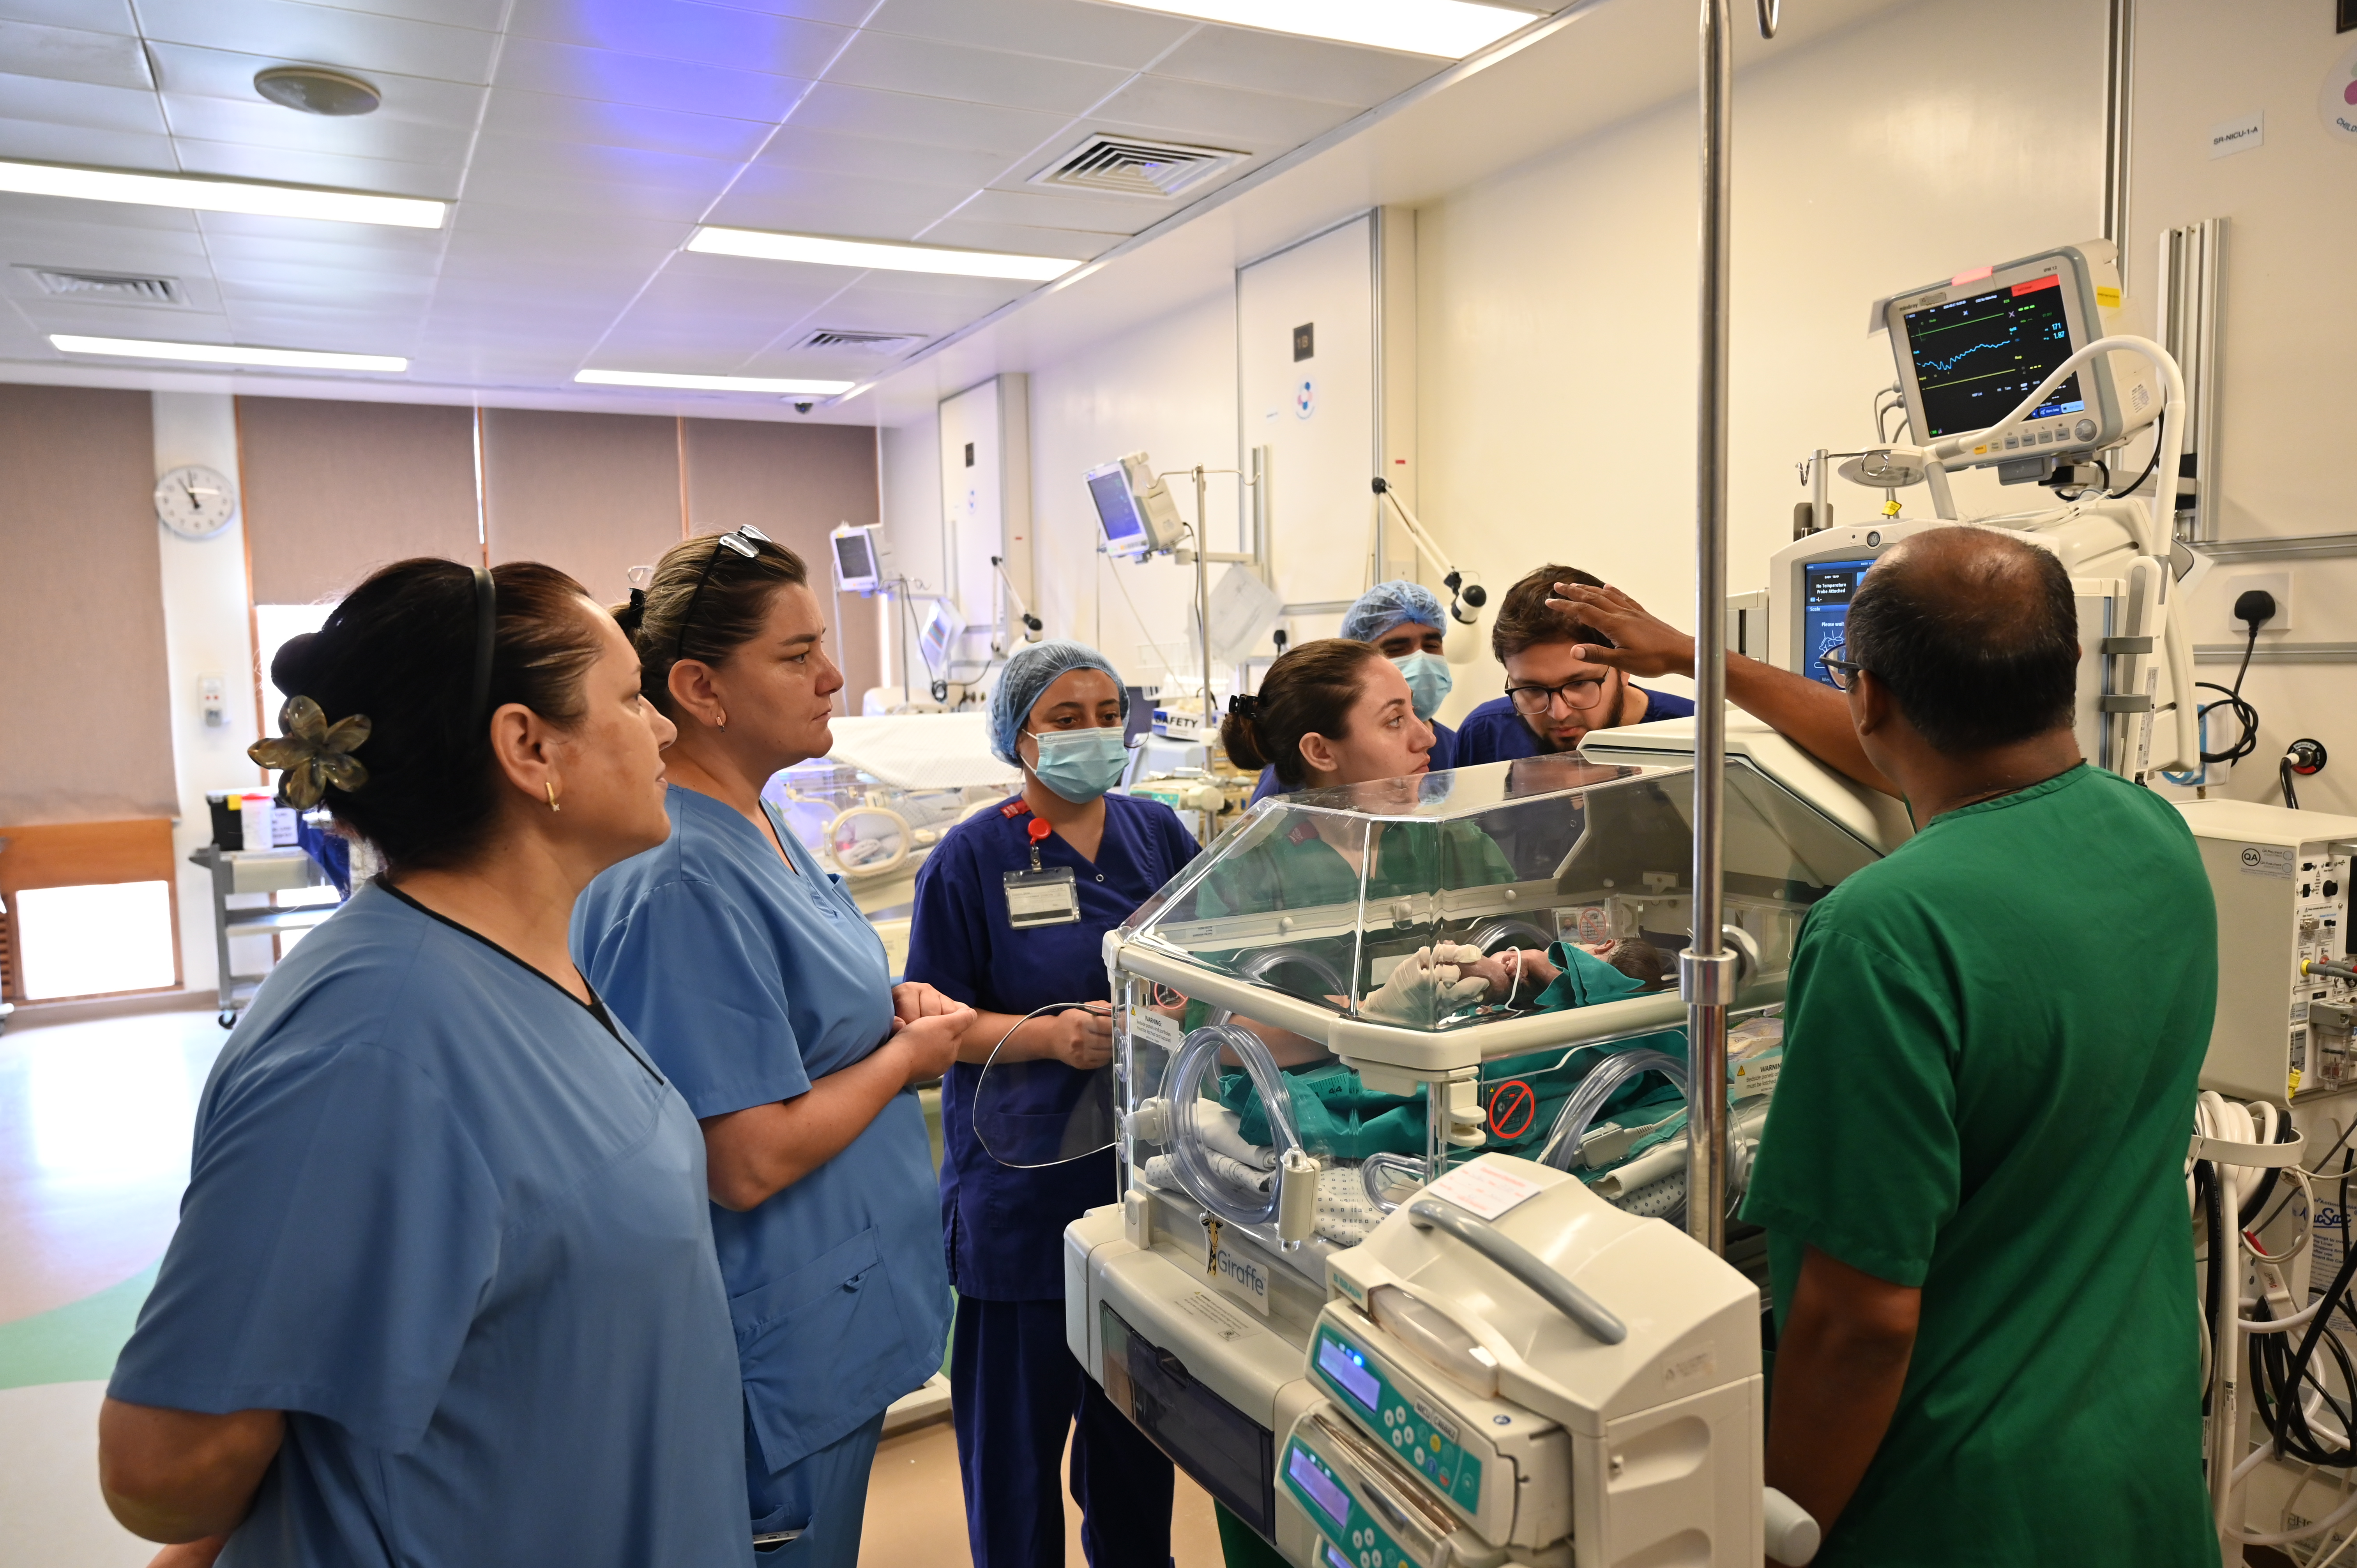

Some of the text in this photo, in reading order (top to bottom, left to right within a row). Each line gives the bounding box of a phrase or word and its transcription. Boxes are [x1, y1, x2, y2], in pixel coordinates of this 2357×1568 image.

[2337, 118, 2357, 132] CHILD
[2214, 126, 2257, 145] SR-NICU-1-A
[2052, 322, 2061, 330] 171
[2053, 331, 2065, 339] 1.87
[1156, 715, 1198, 728] SAFETY
[2244, 853, 2258, 861] QA
[1145, 1015, 1162, 1027] WARNING:
[1760, 1063, 1781, 1072] WARNIN
[1217, 1250, 1263, 1296] Giraffe
